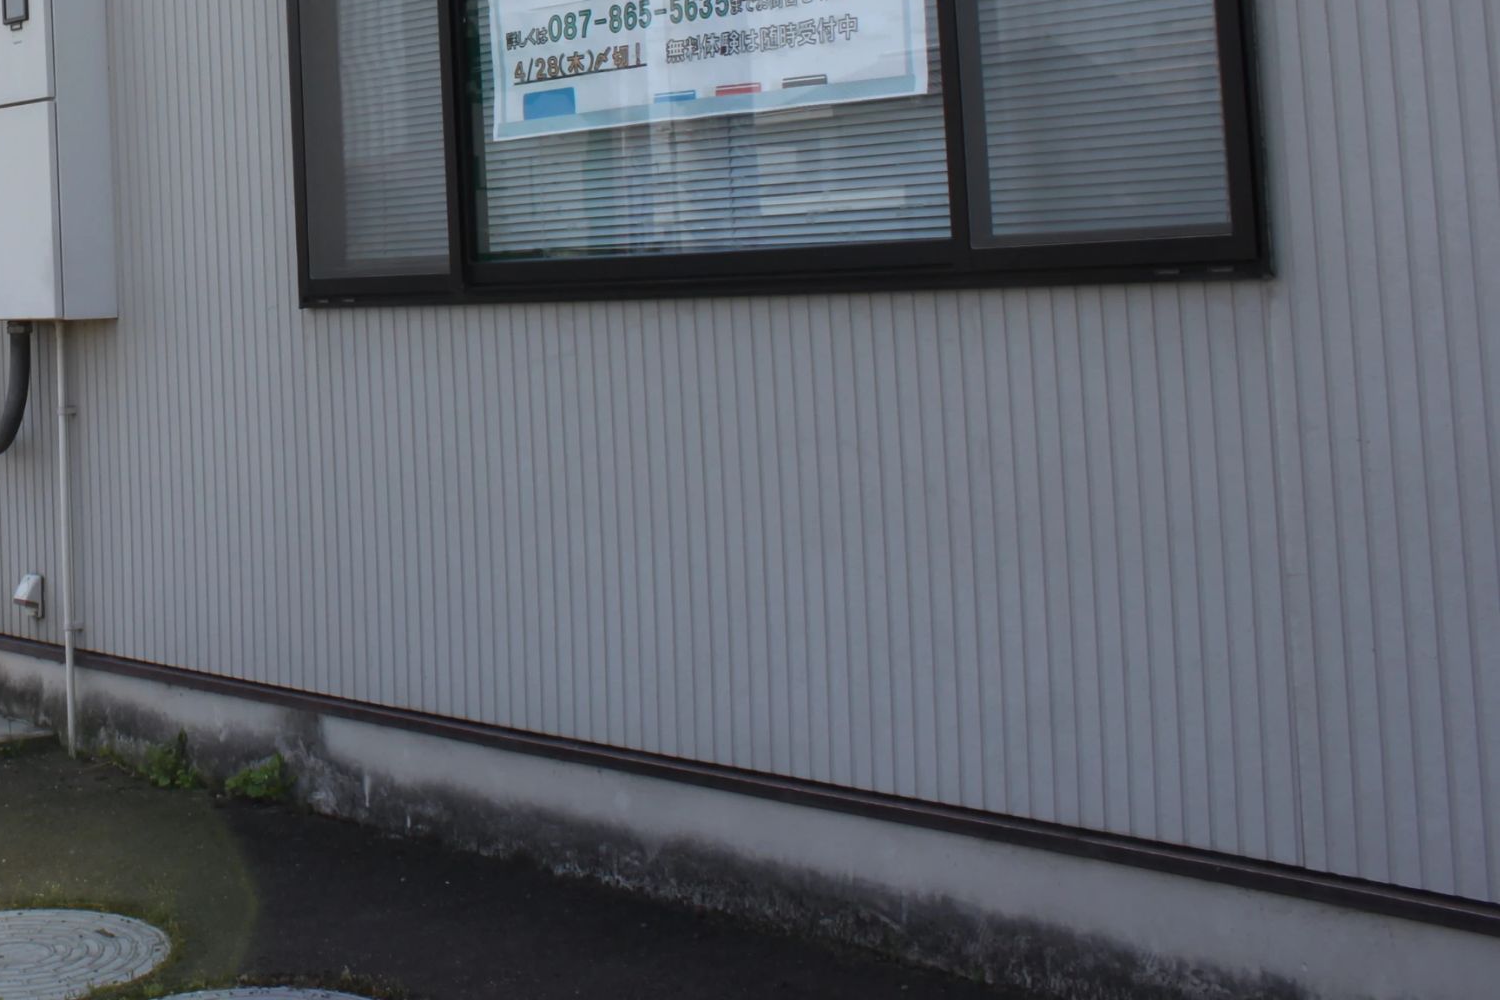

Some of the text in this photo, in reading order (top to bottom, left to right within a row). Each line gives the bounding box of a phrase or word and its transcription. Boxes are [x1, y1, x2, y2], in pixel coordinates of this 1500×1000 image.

[665, 13, 858, 64] 無料体験は随時受付中
